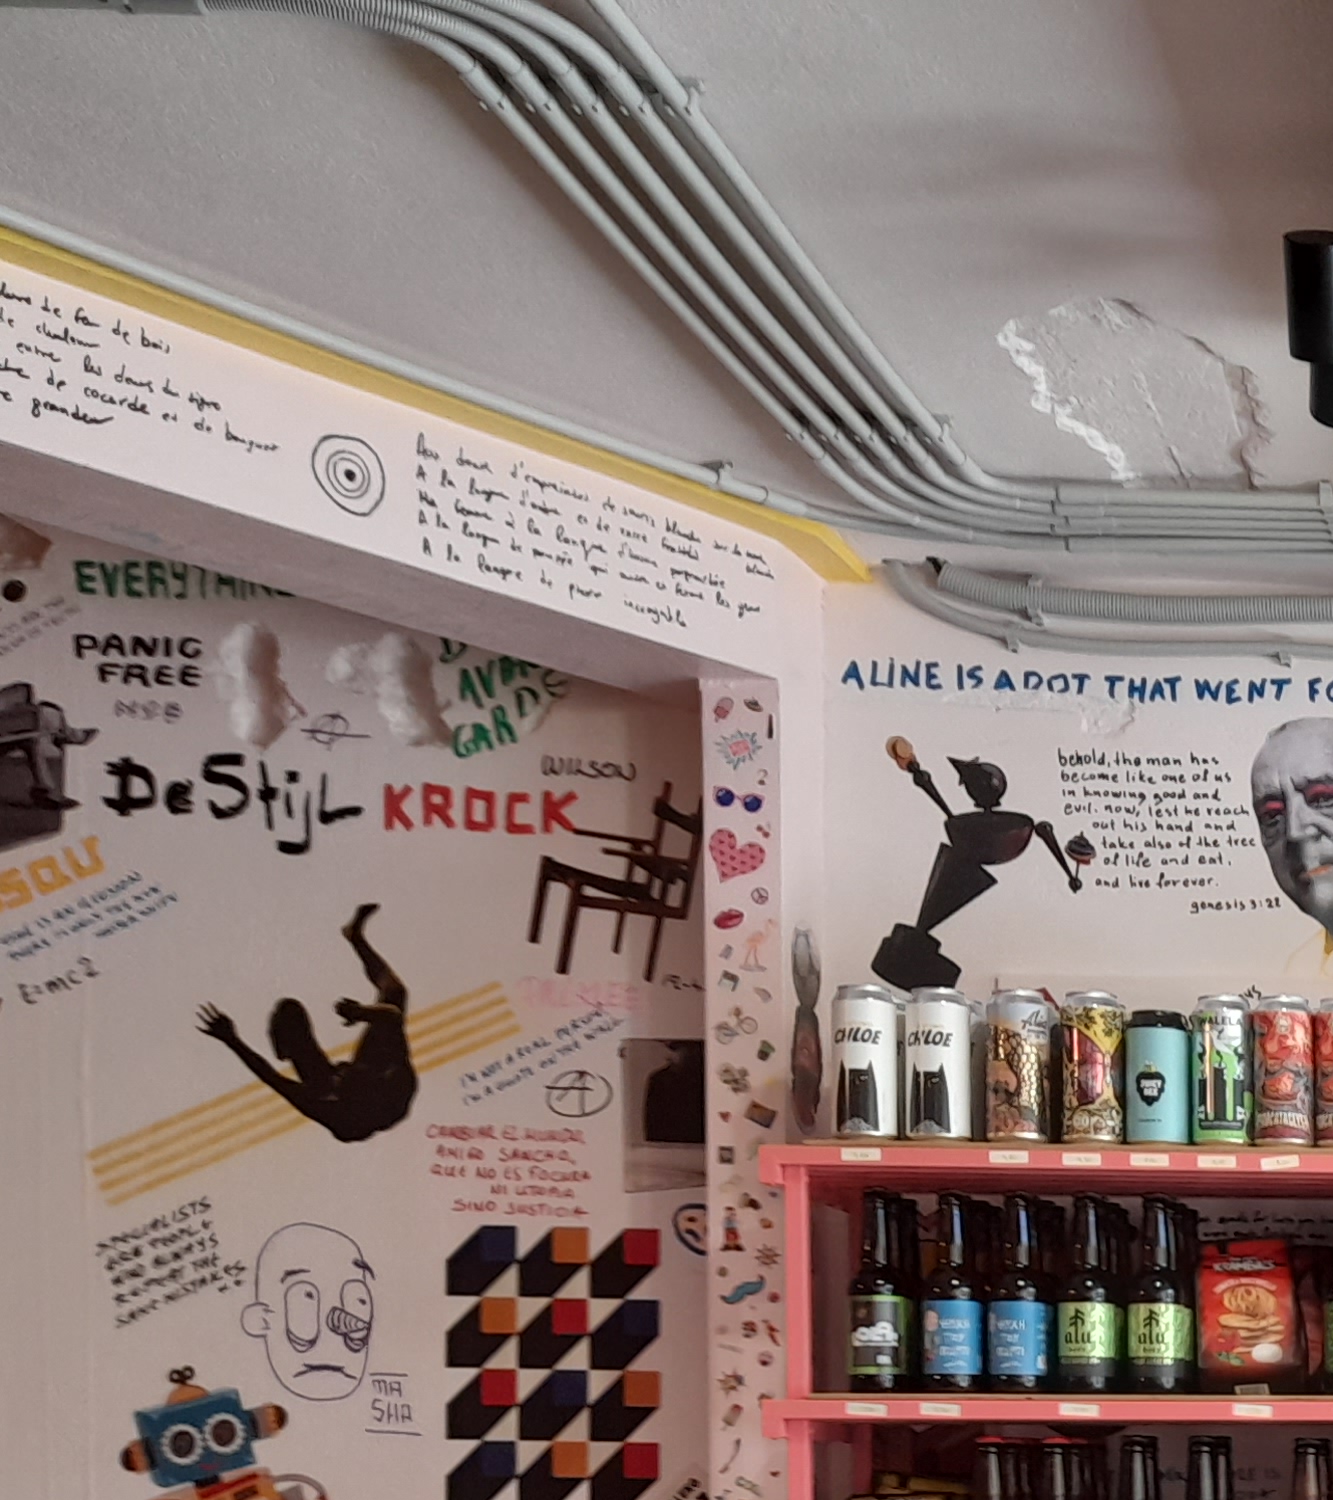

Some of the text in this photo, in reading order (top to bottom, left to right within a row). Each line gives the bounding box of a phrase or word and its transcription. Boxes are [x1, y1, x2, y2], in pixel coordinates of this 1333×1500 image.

[98, 664, 202, 688] FREE
[1104, 674, 1182, 703] THAT
[1194, 678, 1293, 703] WENT
[1116, 752, 1141, 767] the
[1146, 754, 1182, 766] man
[1190, 752, 1219, 765] has
[1061, 769, 1232, 784] become like one of us
[1062, 787, 1222, 806] in knowing good and
[382, 782, 579, 835] KROCK
[1149, 805, 1178, 817] lest
[1184, 804, 1201, 816] he
[1207, 804, 1250, 816] reach
[1092, 820, 1237, 833] out his hand and
[1101, 834, 1256, 850] take also of the tree
[1103, 853, 1120, 867] of
[1125, 853, 1152, 868] life
[1161, 853, 1189, 866] and
[1095, 877, 1120, 889] and
[1129, 874, 1151, 889] live
[1190, 900, 1246, 914] genesis
